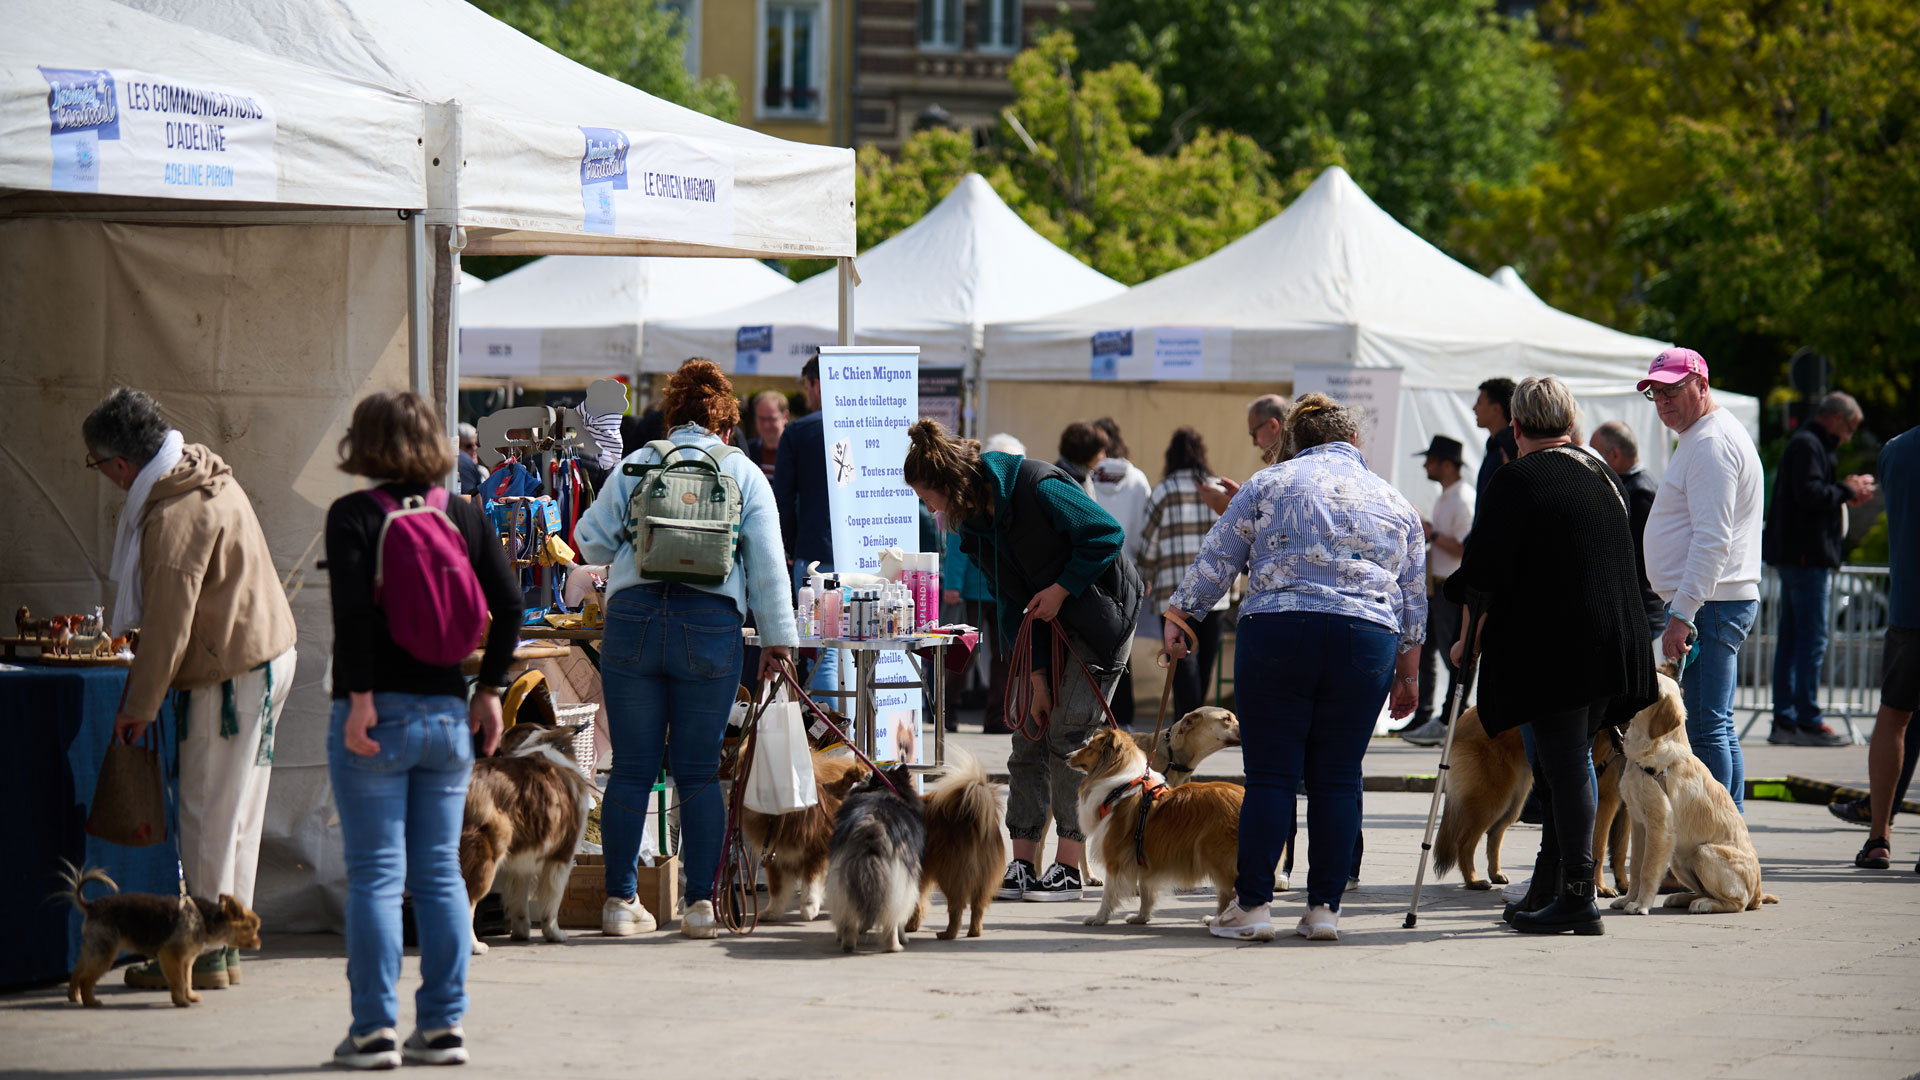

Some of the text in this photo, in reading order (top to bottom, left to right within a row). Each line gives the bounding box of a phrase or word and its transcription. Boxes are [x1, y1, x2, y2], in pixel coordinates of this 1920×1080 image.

[127, 82, 263, 120] LES COMMUNICATIONS
[166, 121, 226, 152] D'ADELINE
[164, 162, 234, 188] ADELINE PIRON
[644, 172, 716, 203] LE CHIEN MIGNON
[828, 366, 840, 380] Le
[843, 366, 872, 380] Chien
[873, 366, 912, 383] Mignon
[835, 395, 907, 408] Salon de toilettage
[834, 415, 911, 429] canin et félin depuis
[865, 439, 880, 449] 1992
[861, 465, 904, 477] Toutes race
[855, 487, 914, 498] sur rendez-vous
[847, 513, 912, 528] Coupe aux ciseaux
[859, 556, 876, 569] Bain
[919, 575, 927, 625] SPLENDID
[876, 651, 904, 665] orbeille,
